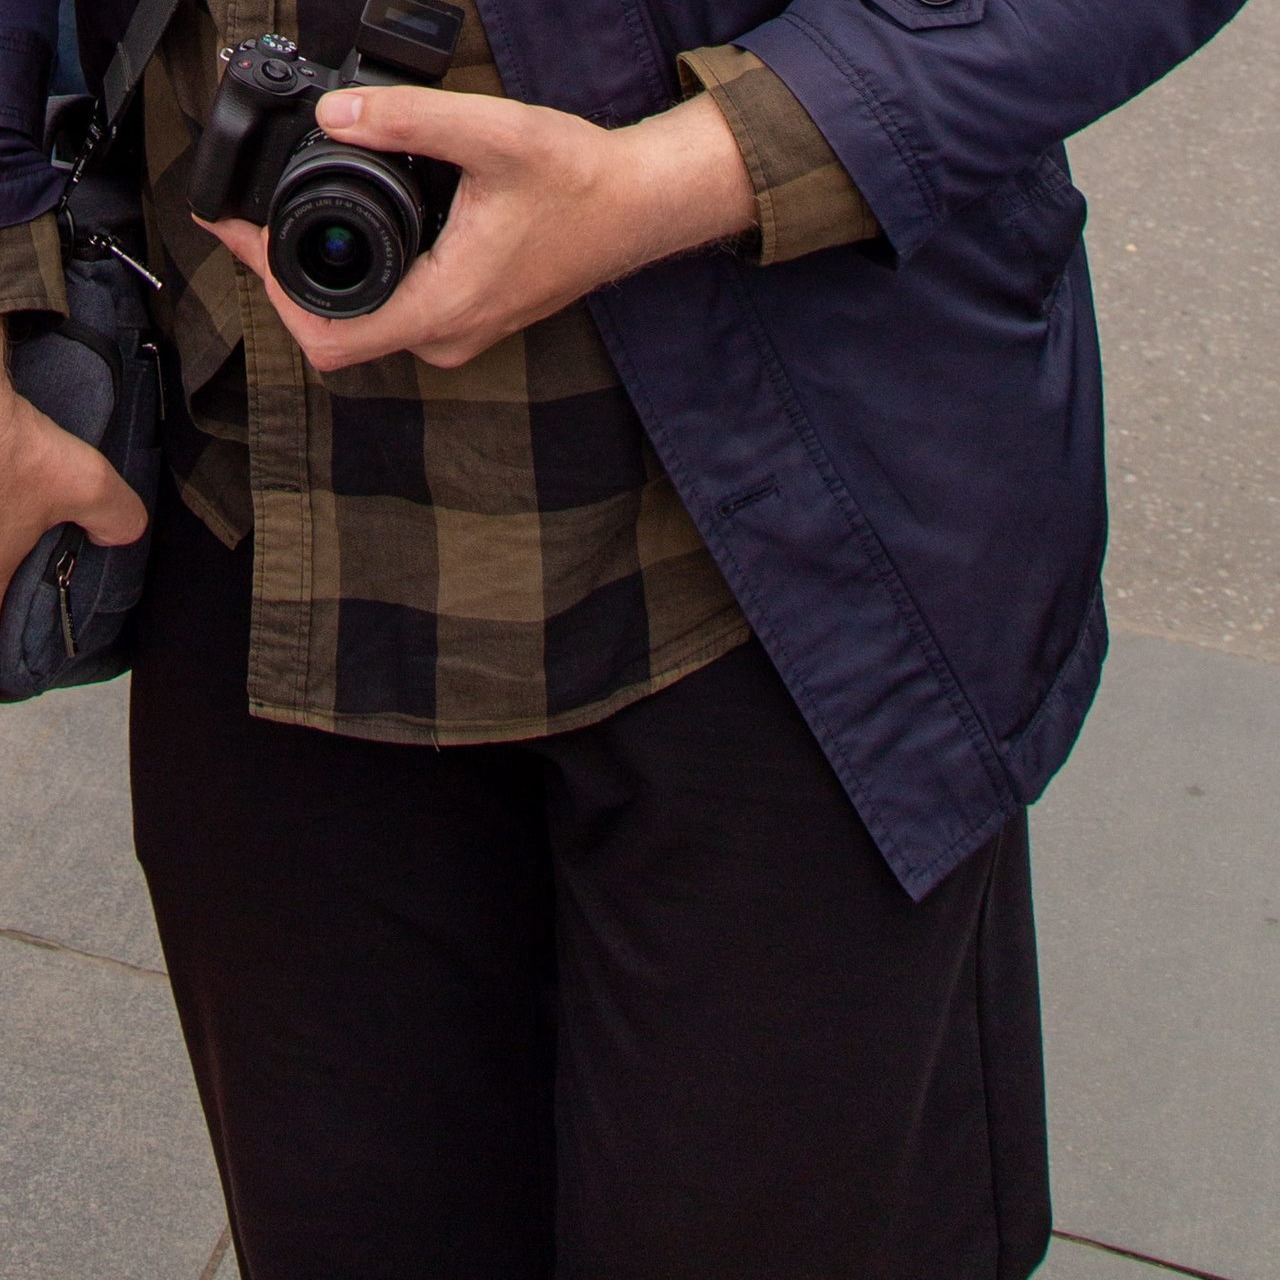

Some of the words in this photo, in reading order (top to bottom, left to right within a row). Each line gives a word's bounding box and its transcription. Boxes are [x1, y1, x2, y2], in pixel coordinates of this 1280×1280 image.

[280, 217, 295, 240] CANON
[294, 203, 313, 218] ZOOM
[316, 199, 333, 207] LENS
